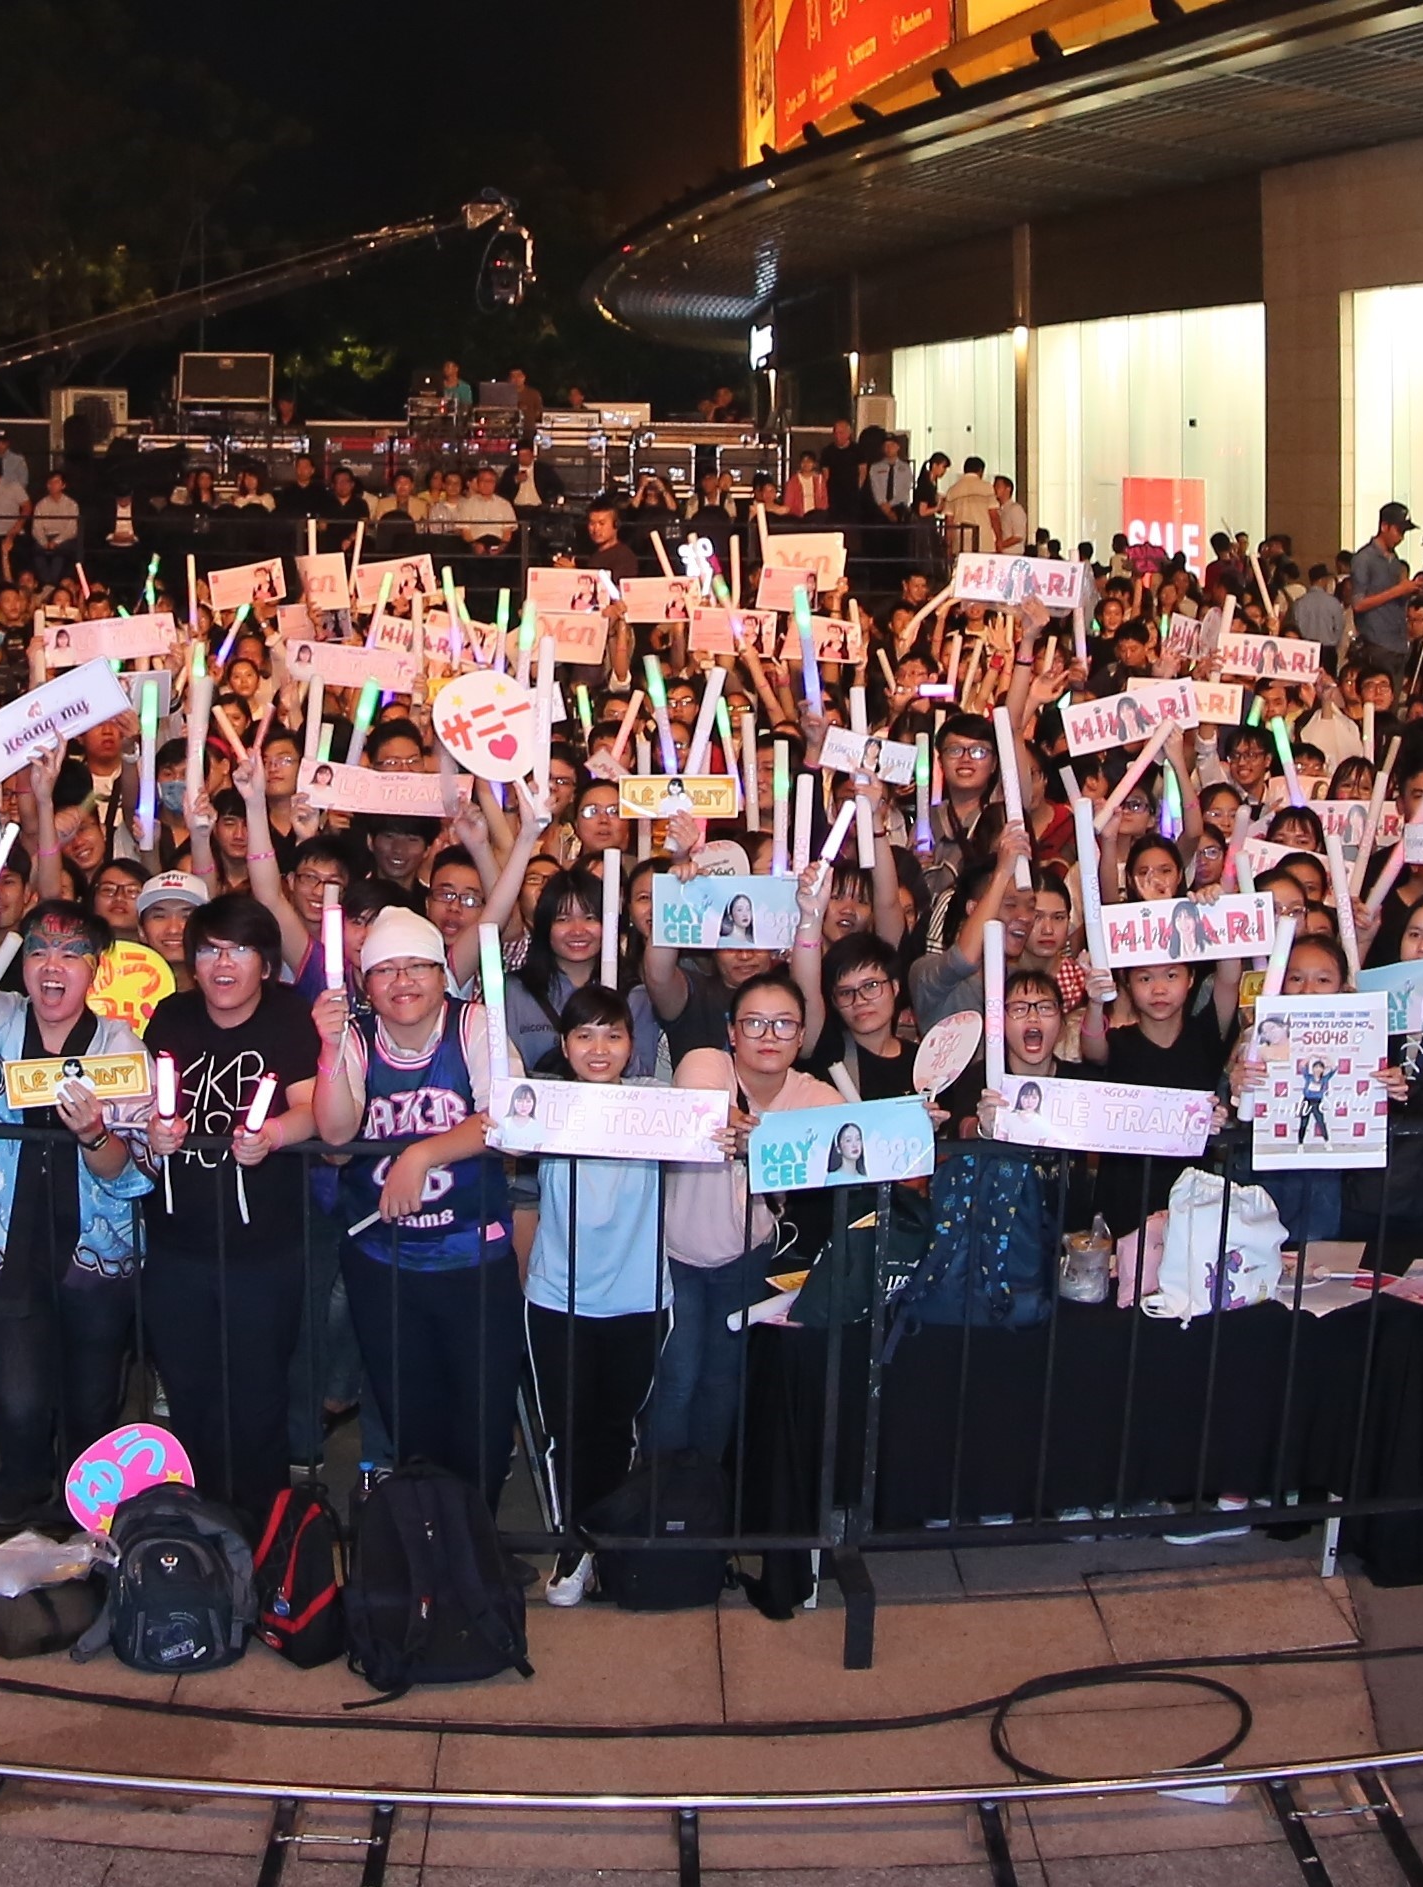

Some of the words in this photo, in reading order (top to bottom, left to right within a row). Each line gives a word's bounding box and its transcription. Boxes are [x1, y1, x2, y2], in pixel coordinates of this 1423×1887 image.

[1128, 519, 1200, 579] SALE
[304, 570, 337, 593] on
[442, 701, 531, 751] サニー
[663, 902, 707, 924] KAY
[662, 924, 703, 945] CEE
[1388, 990, 1411, 1011] AY
[1388, 1011, 1408, 1031] EE
[1301, 1030, 1349, 1045] SGO48
[602, 1105, 723, 1139] TRANG
[1104, 1103, 1207, 1136] TRANG
[760, 1140, 812, 1166] KAY
[762, 1163, 808, 1187] CEE
[68, 1428, 167, 1514] ゆう
